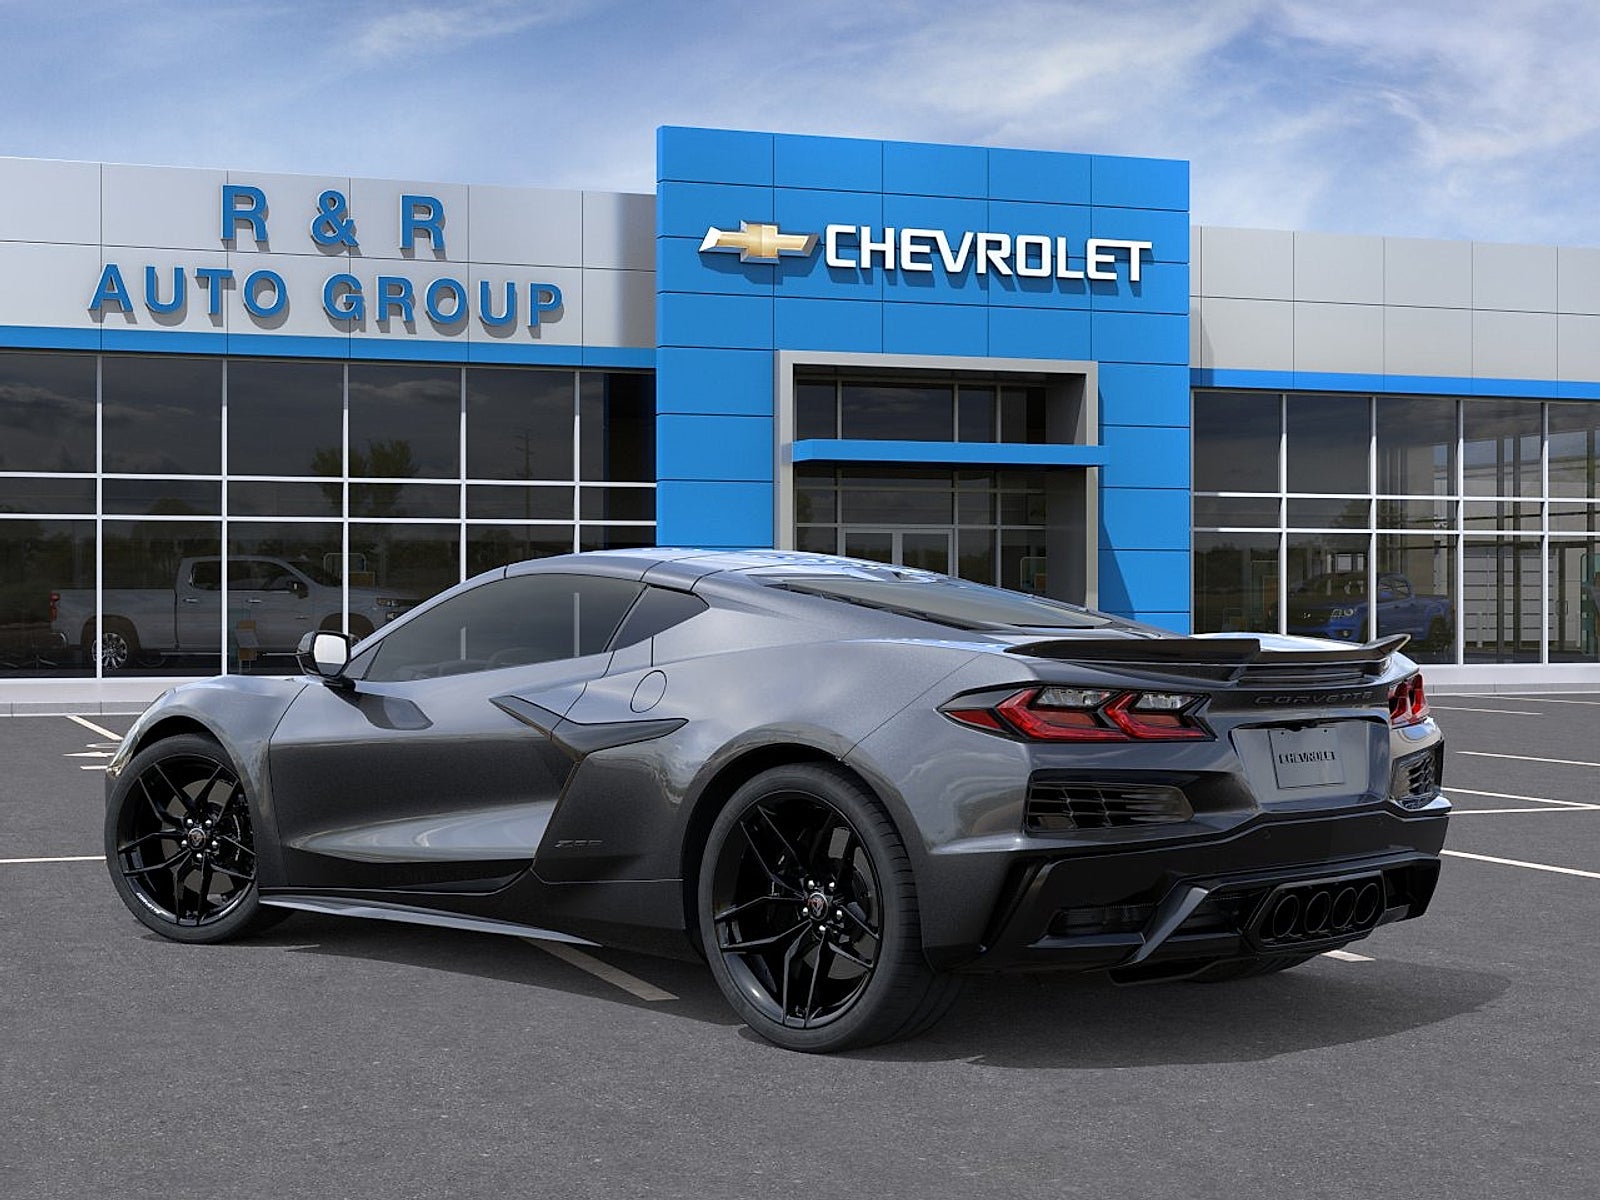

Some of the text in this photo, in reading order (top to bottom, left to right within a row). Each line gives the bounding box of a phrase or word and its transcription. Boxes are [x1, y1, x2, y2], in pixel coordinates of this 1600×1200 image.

[221, 184, 446, 251] R & R
[825, 223, 1153, 282] CHEVROLET
[88, 263, 564, 328] AUTO GROUP
